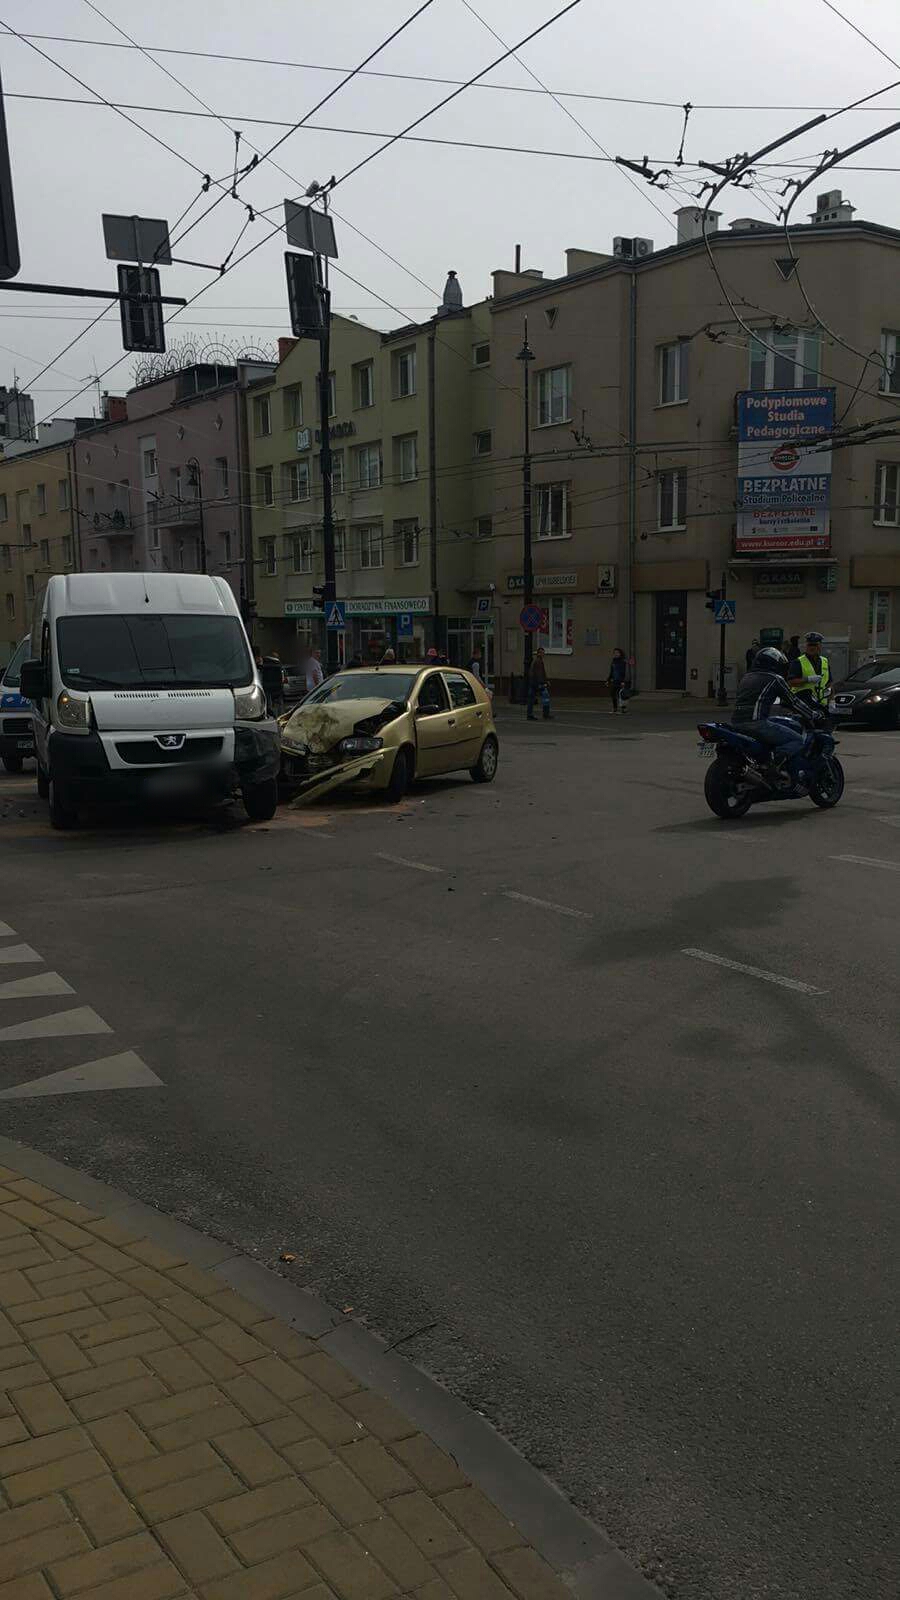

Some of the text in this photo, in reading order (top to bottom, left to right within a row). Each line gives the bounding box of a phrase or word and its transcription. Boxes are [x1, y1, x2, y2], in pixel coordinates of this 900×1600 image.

[746, 396, 827, 410] Podyplomowe
[767, 410, 805, 422] Studia
[746, 425, 826, 439] Pedagogiczne
[743, 476, 828, 493] BEZPŁATNE
[743, 493, 826, 504] Studium Policealne
